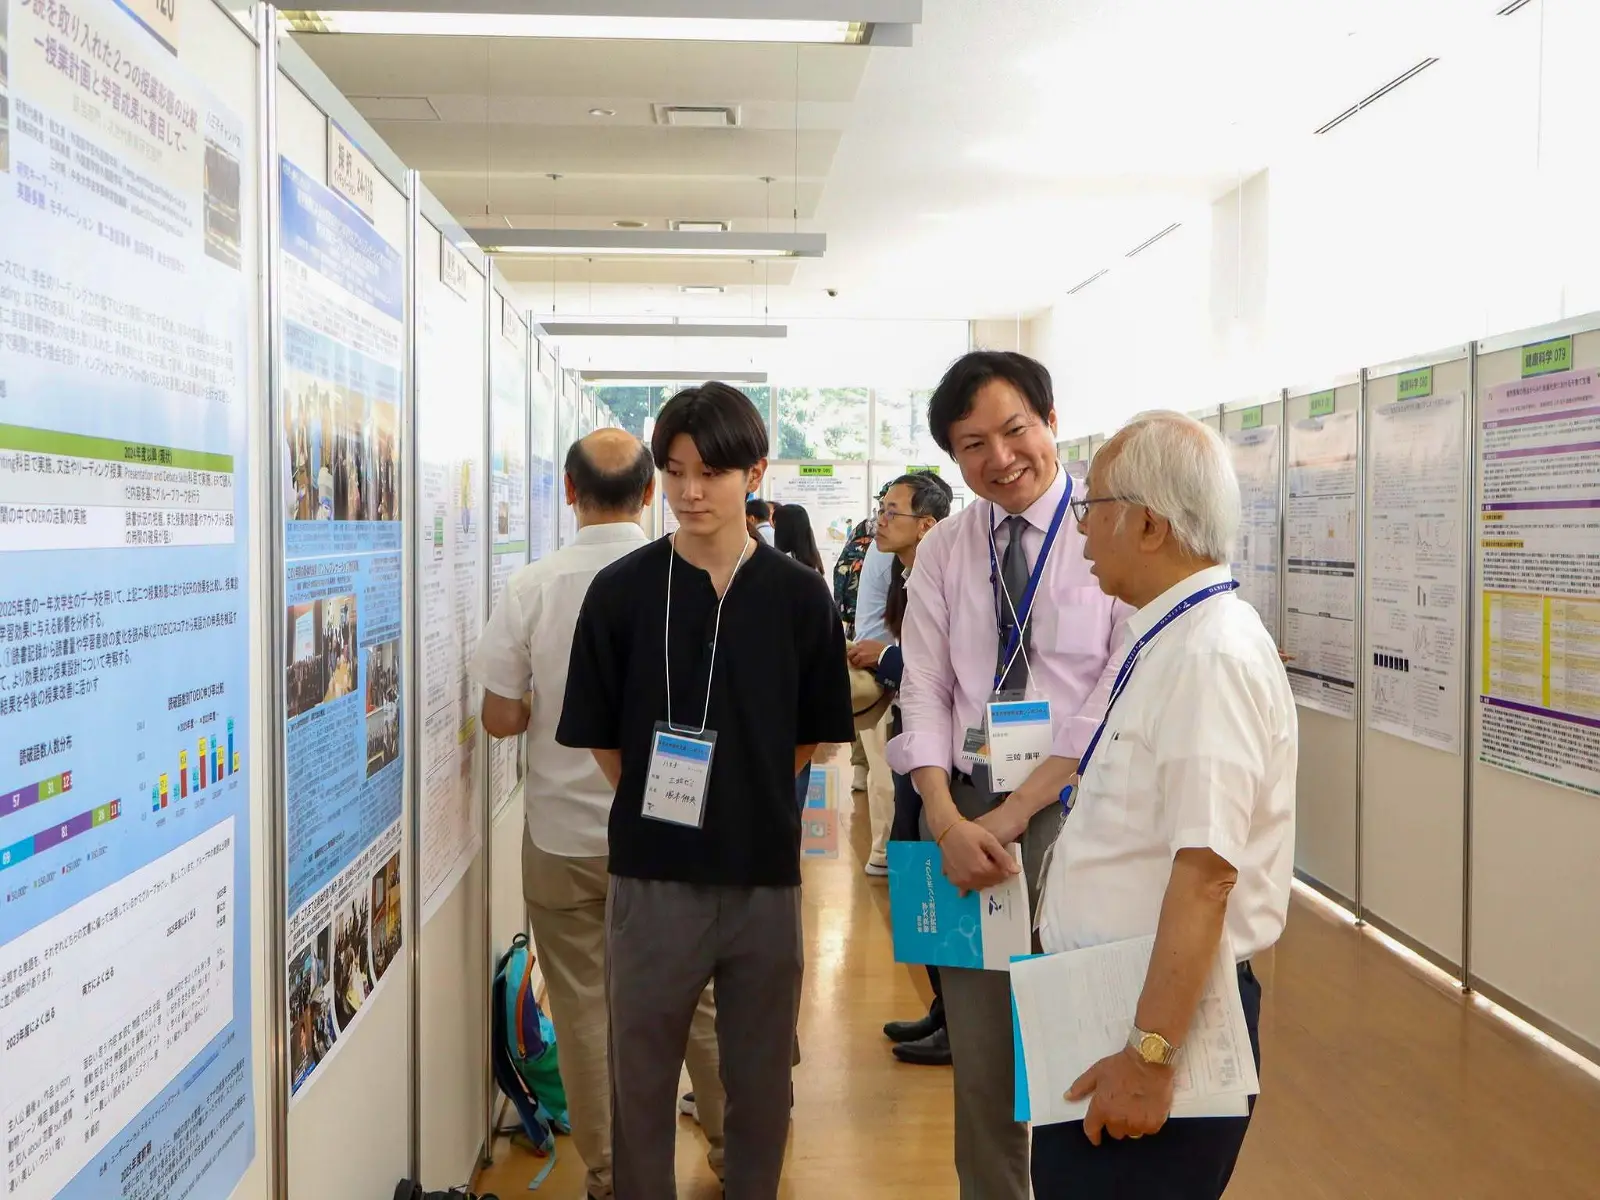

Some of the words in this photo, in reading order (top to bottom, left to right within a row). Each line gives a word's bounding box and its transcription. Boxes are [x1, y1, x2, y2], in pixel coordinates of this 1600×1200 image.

[1525, 349, 1553, 368] 健康科学
[1554, 346, 1567, 363] 079
[12, 793, 20, 808] 57
